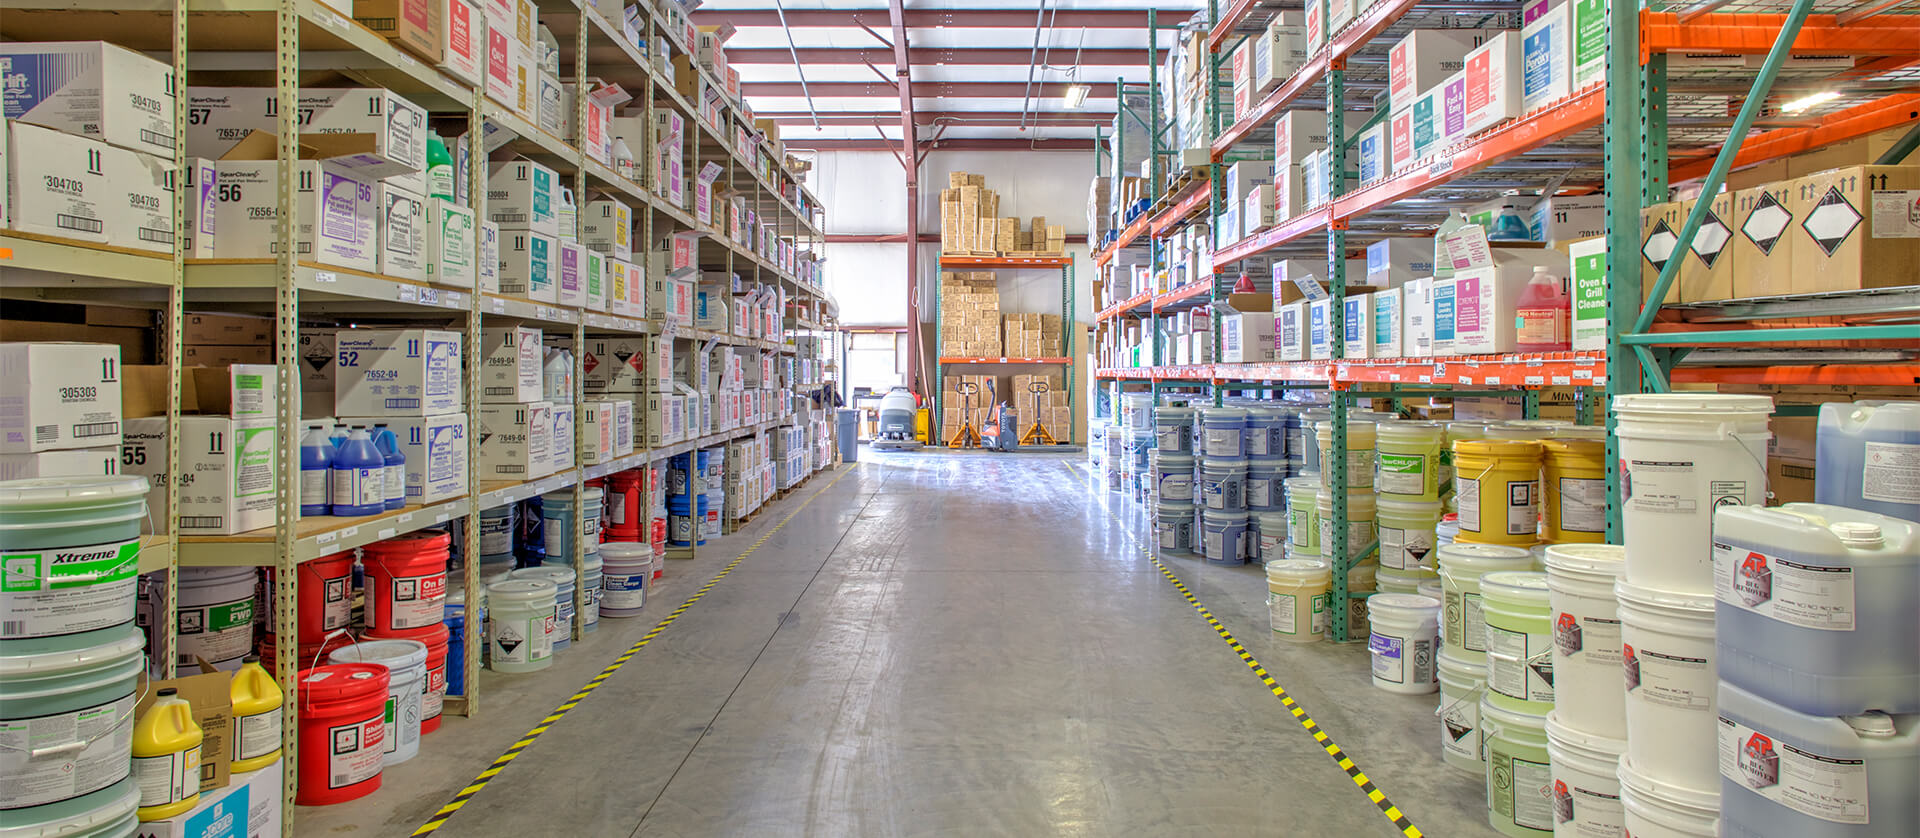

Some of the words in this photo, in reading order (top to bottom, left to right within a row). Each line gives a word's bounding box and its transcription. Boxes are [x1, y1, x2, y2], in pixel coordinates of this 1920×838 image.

[1274, 34, 1280, 43] 3
[190, 96, 229, 104] SparClean
[189, 109, 211, 125] 57
[413, 111, 423, 129] 57
[219, 170, 261, 178] SparClean
[219, 184, 242, 202] 56
[358, 183, 371, 202] 56
[412, 200, 422, 216] 57
[463, 214, 472, 230] 59
[1555, 211, 1568, 224] 11
[487, 228, 496, 243] 61
[1579, 279, 1598, 289] Oven
[1586, 287, 1602, 298] Grill
[1578, 299, 1606, 309] Cleane
[448, 341, 457, 356] 52
[339, 351, 359, 366] 52
[123, 432, 165, 440] SparClean
[454, 424, 463, 439] 52
[123, 446, 146, 465] 55
[242, 456, 270, 466] Delimer
[52, 550, 116, 564] Xtreme
[423, 580, 436, 589] On
[1735, 583, 1769, 599] REMOVER
[1745, 580, 1760, 590] BUG
[1739, 761, 1775, 783] REMOVER
[1750, 760, 1764, 771] BUG
